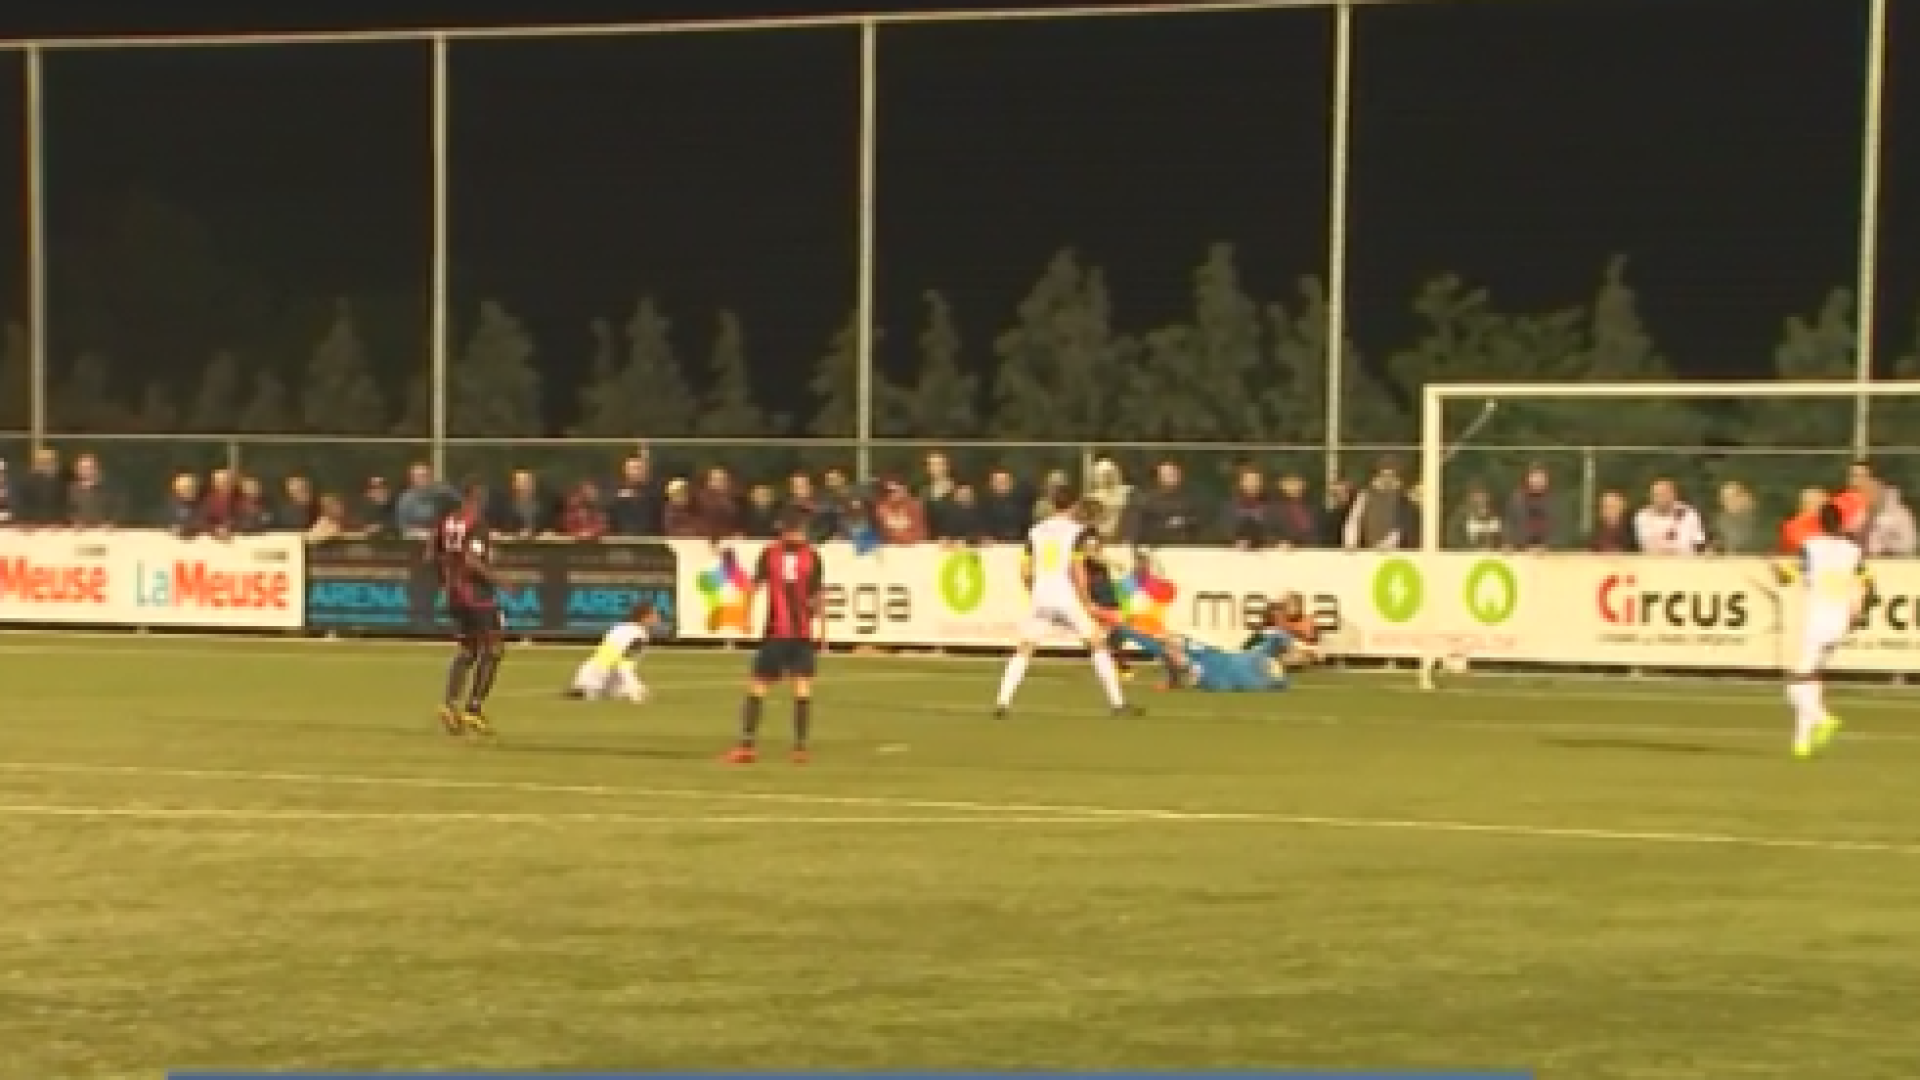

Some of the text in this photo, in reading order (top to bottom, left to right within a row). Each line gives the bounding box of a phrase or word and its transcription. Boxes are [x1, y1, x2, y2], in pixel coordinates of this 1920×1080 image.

[309, 582, 409, 608] ARENA
[822, 583, 912, 634] ega
[1192, 590, 1342, 633] mea
[1595, 573, 1749, 627] Circus
